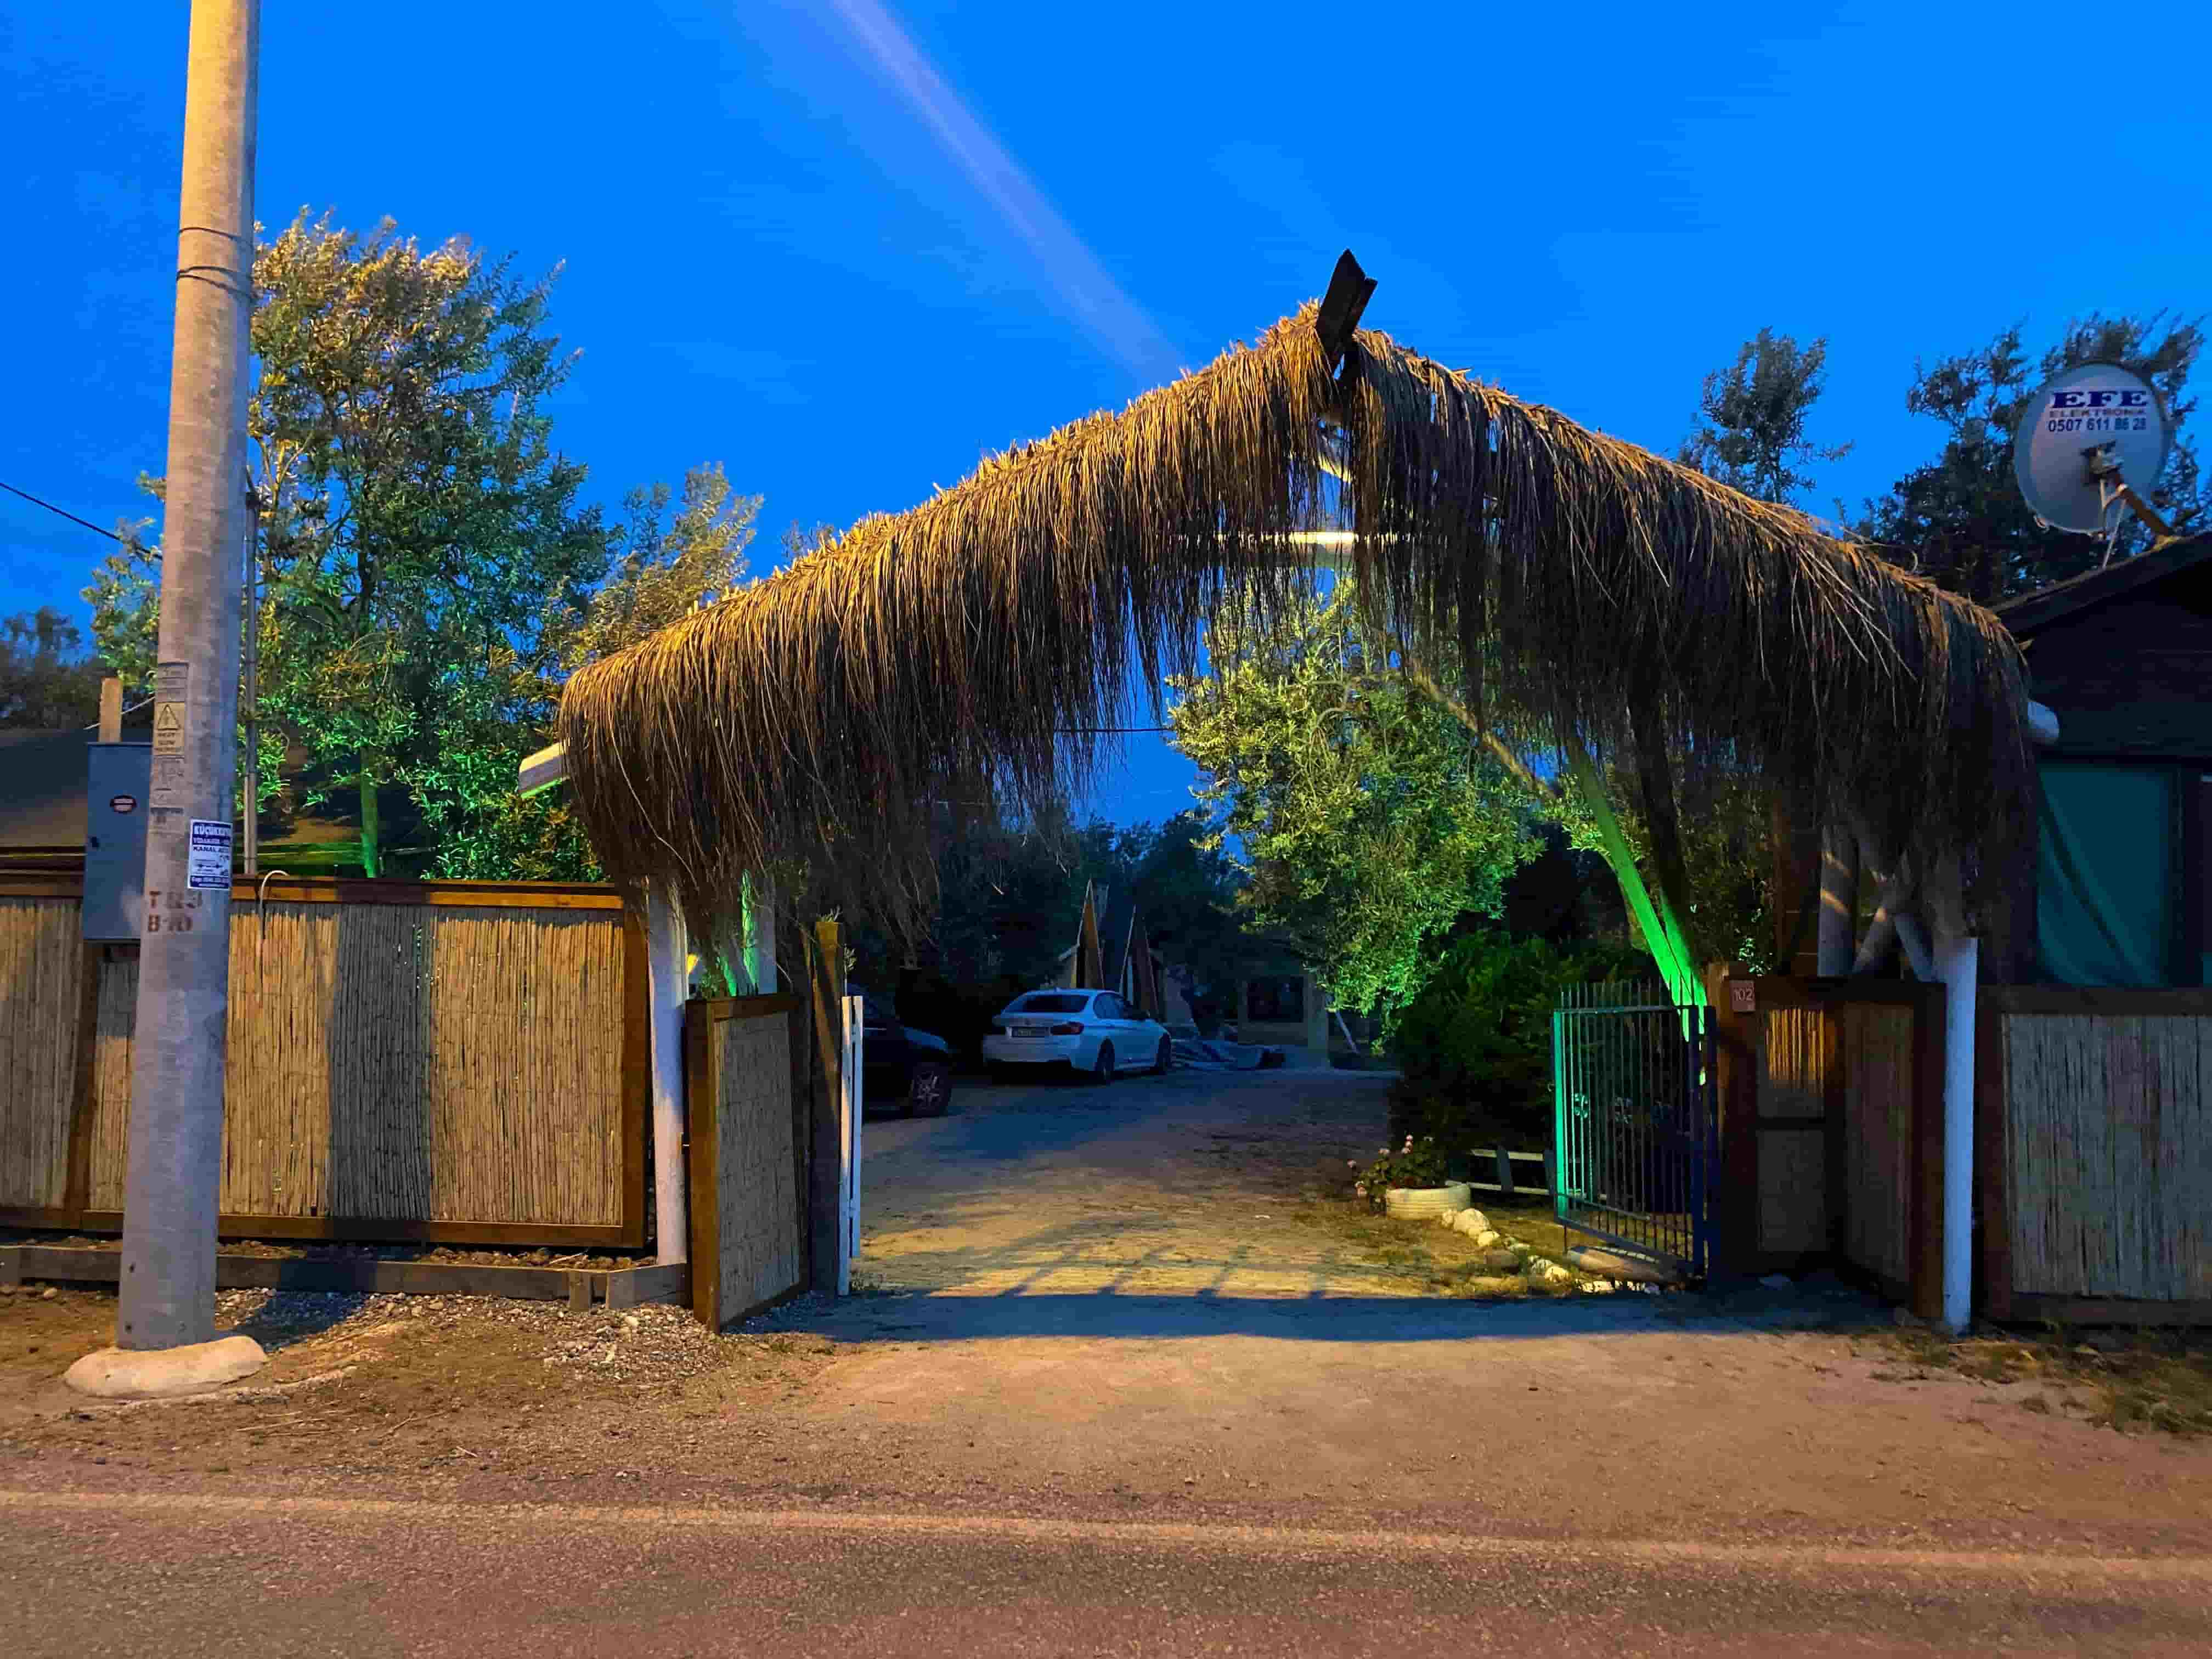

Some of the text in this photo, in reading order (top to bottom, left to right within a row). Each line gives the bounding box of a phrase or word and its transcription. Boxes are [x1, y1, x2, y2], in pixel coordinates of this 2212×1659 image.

[2051, 391, 2148, 408] EFE
[2048, 419, 2083, 432] 0507
[2086, 418, 2110, 431] 611
[1734, 988, 1753, 1001] 102
